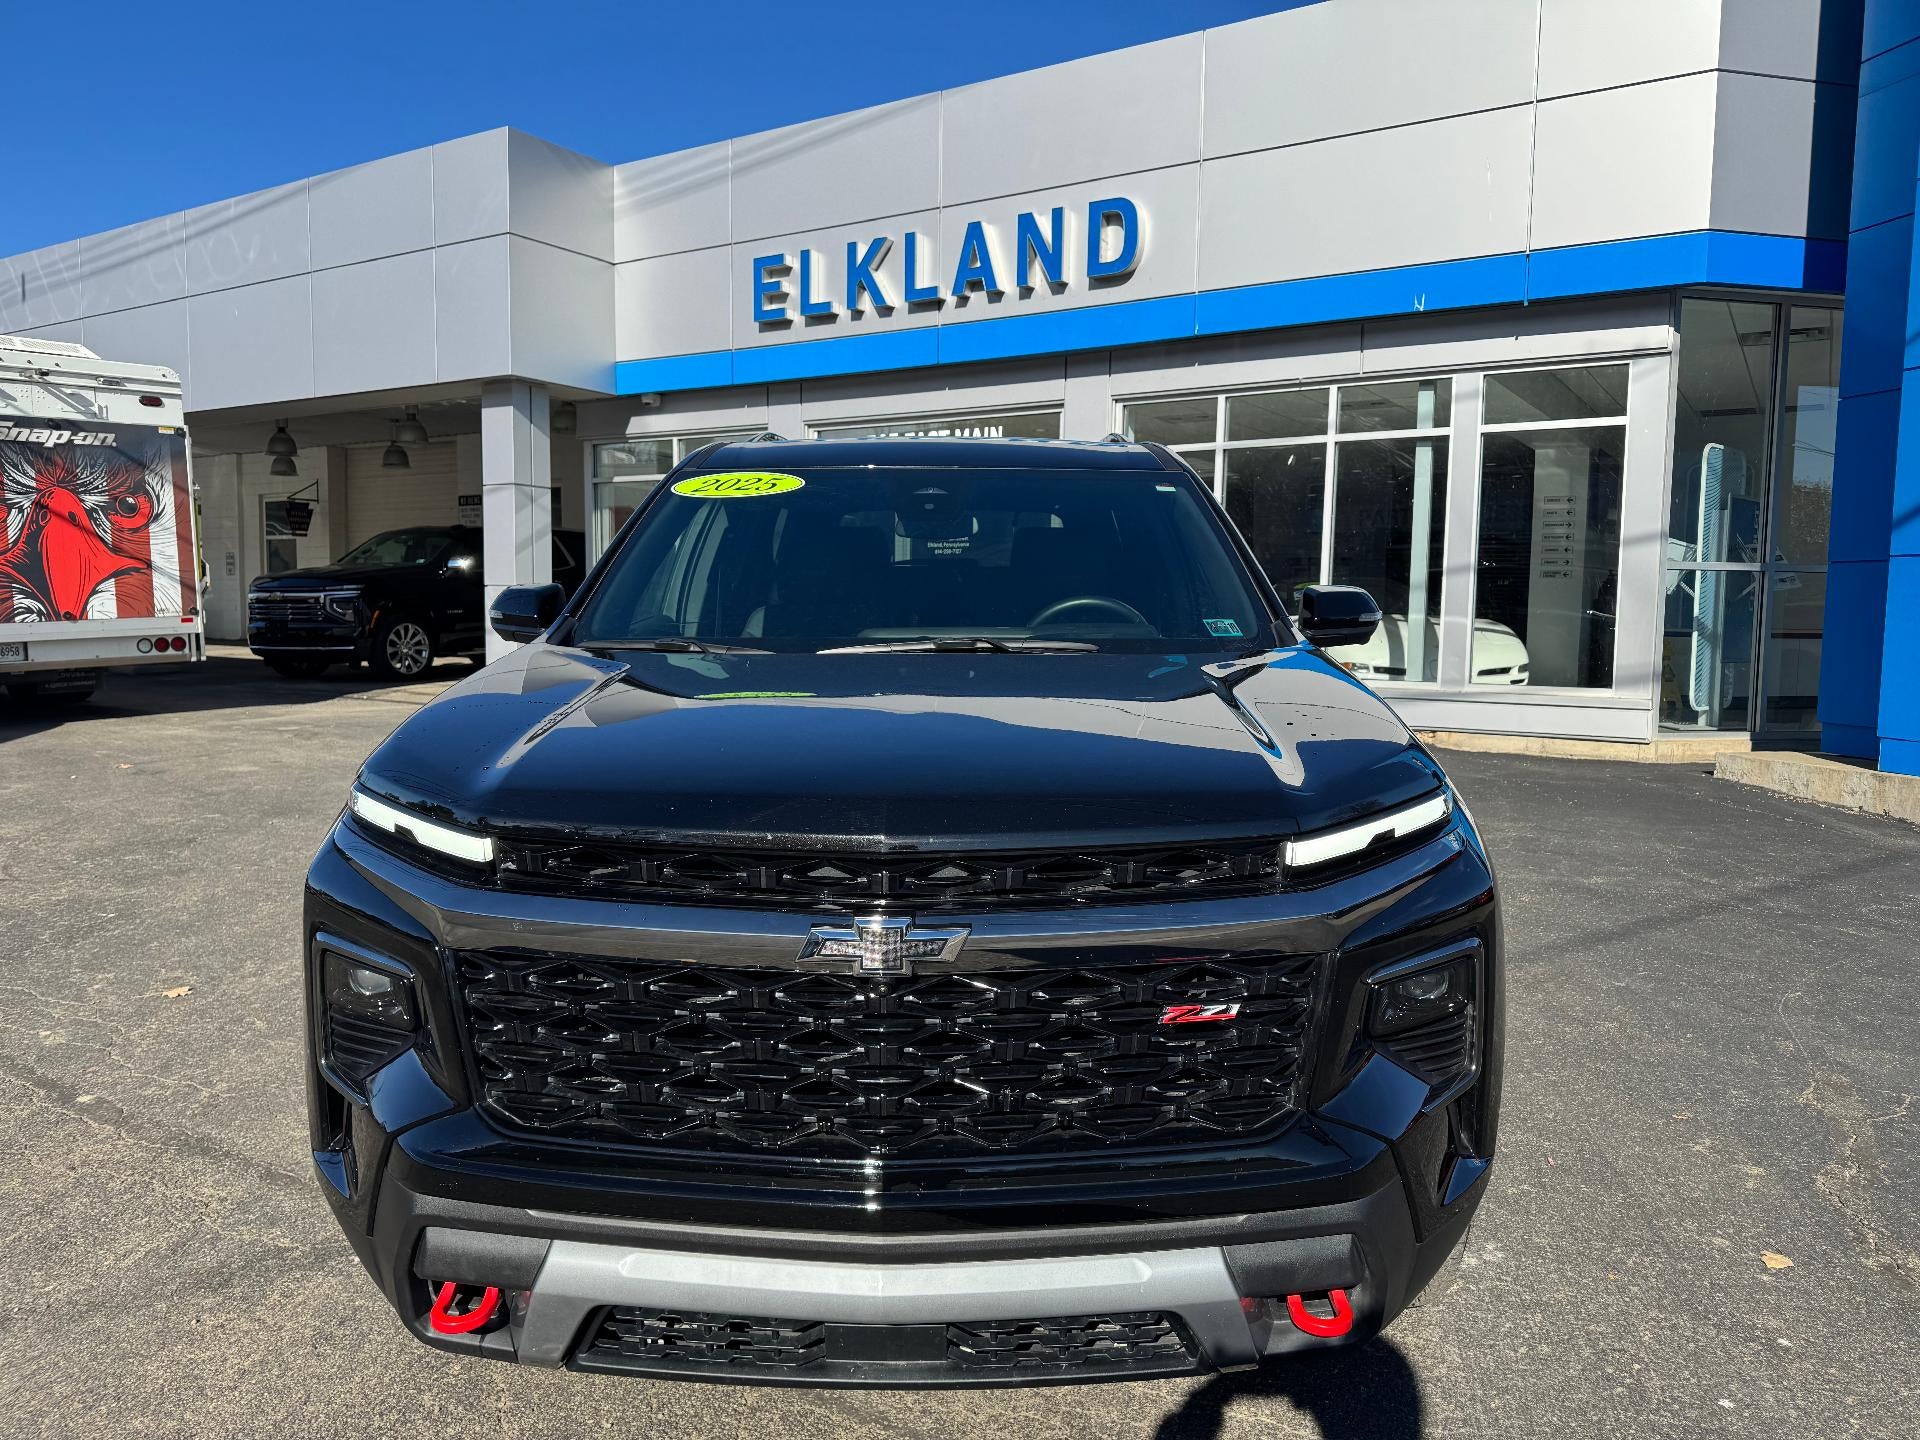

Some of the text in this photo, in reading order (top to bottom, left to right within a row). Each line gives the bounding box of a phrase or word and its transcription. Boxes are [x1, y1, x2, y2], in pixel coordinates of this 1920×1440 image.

[753, 196, 1142, 325] ELKLAND
[690, 477, 787, 493] 2025
[1158, 1003, 1241, 1024] Z71
